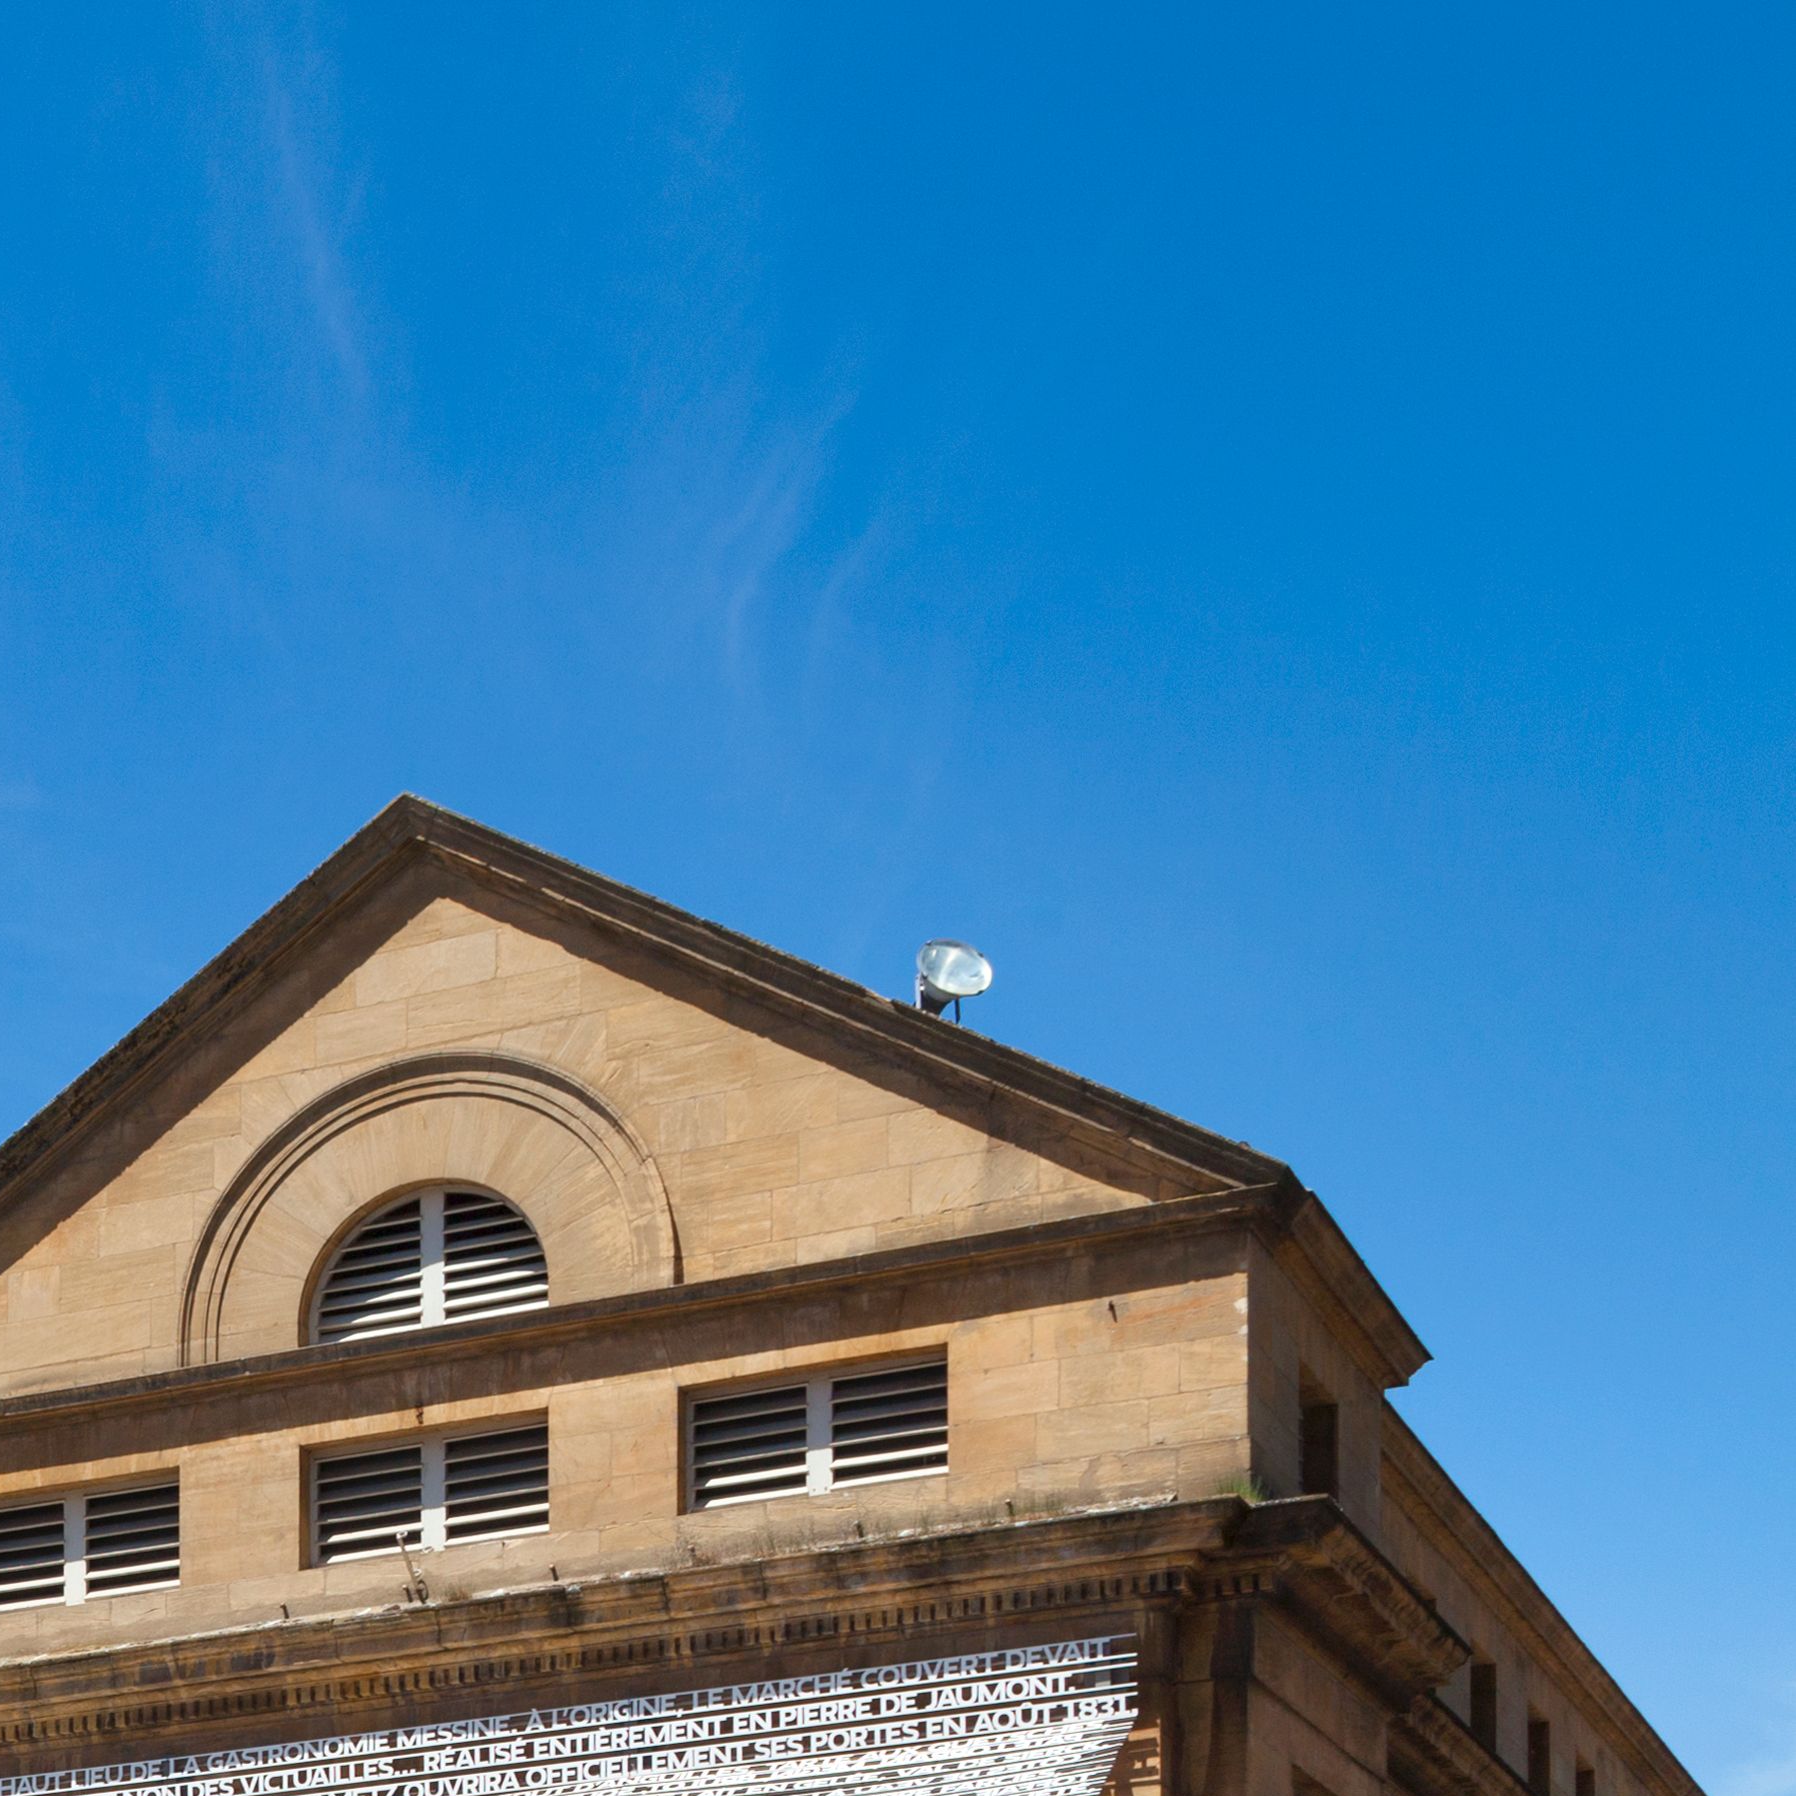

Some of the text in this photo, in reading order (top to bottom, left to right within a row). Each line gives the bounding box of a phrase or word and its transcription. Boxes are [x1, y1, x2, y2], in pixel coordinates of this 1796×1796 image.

[71, 1761, 123, 1788] LIEU
[130, 1757, 158, 1780] DE
[167, 1752, 200, 1776] LA
[208, 1728, 388, 1771] GASTRONOMIE
[396, 1712, 516, 1747] MESSINE.
[525, 1706, 547, 1731] À
[692, 1686, 722, 1711] LE
[732, 1668, 850, 1706] MARCHÉ
[861, 1651, 1000, 1690] COUVERT
[1008, 1637, 1111, 1672] DEVAIT
[423, 1737, 525, 1771] RÉALISÉ
[534, 1712, 726, 1758] ENTIÈREMENT
[733, 1708, 771, 1734] EN
[779, 1695, 872, 1728] PIERRE
[880, 1690, 917, 1716] DE
[925, 1670, 1075, 1710] JAUMONT.
[525, 1740, 748, 1788] OFFICIELLEMENT
[754, 1733, 803, 1761] SES
[812, 1719, 919, 1754] PORTES
[926, 1714, 966, 1740] EN
[973, 1701, 1057, 1735] AOÛT
[1065, 1693, 1137, 1724] 1831.
